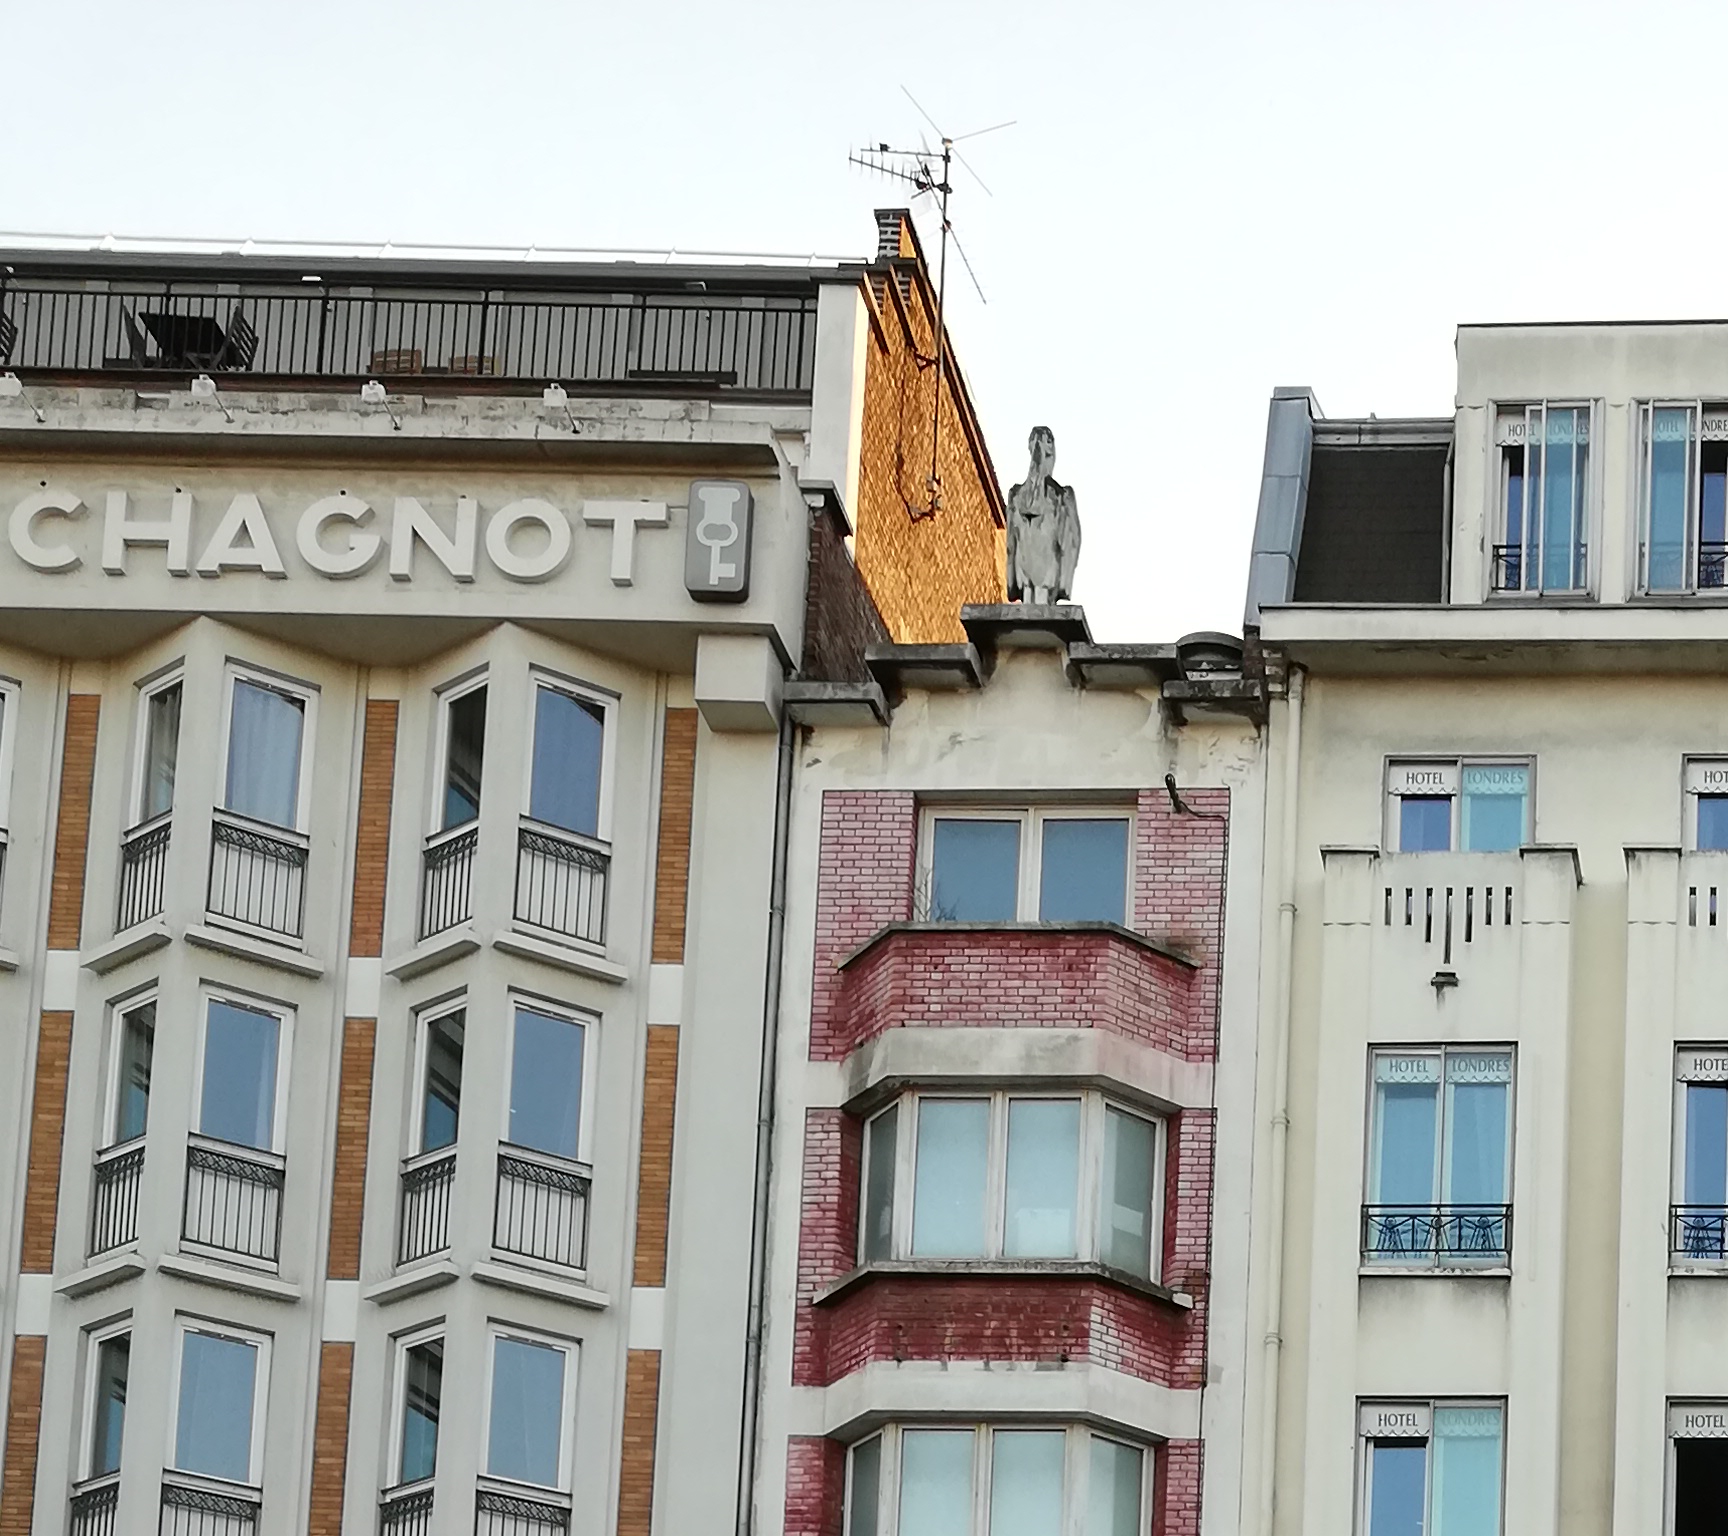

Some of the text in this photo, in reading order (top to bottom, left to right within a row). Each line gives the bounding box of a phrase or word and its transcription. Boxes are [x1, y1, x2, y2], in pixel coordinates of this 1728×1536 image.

[8, 490, 669, 588] CHAGNOT
[1406, 770, 1524, 785] HOTEL LONDRES
[1389, 1058, 1509, 1074] HOTEL LONDRES
[1378, 1412, 1418, 1428] HOTEL
[1685, 1414, 1726, 1429] HOTEL
